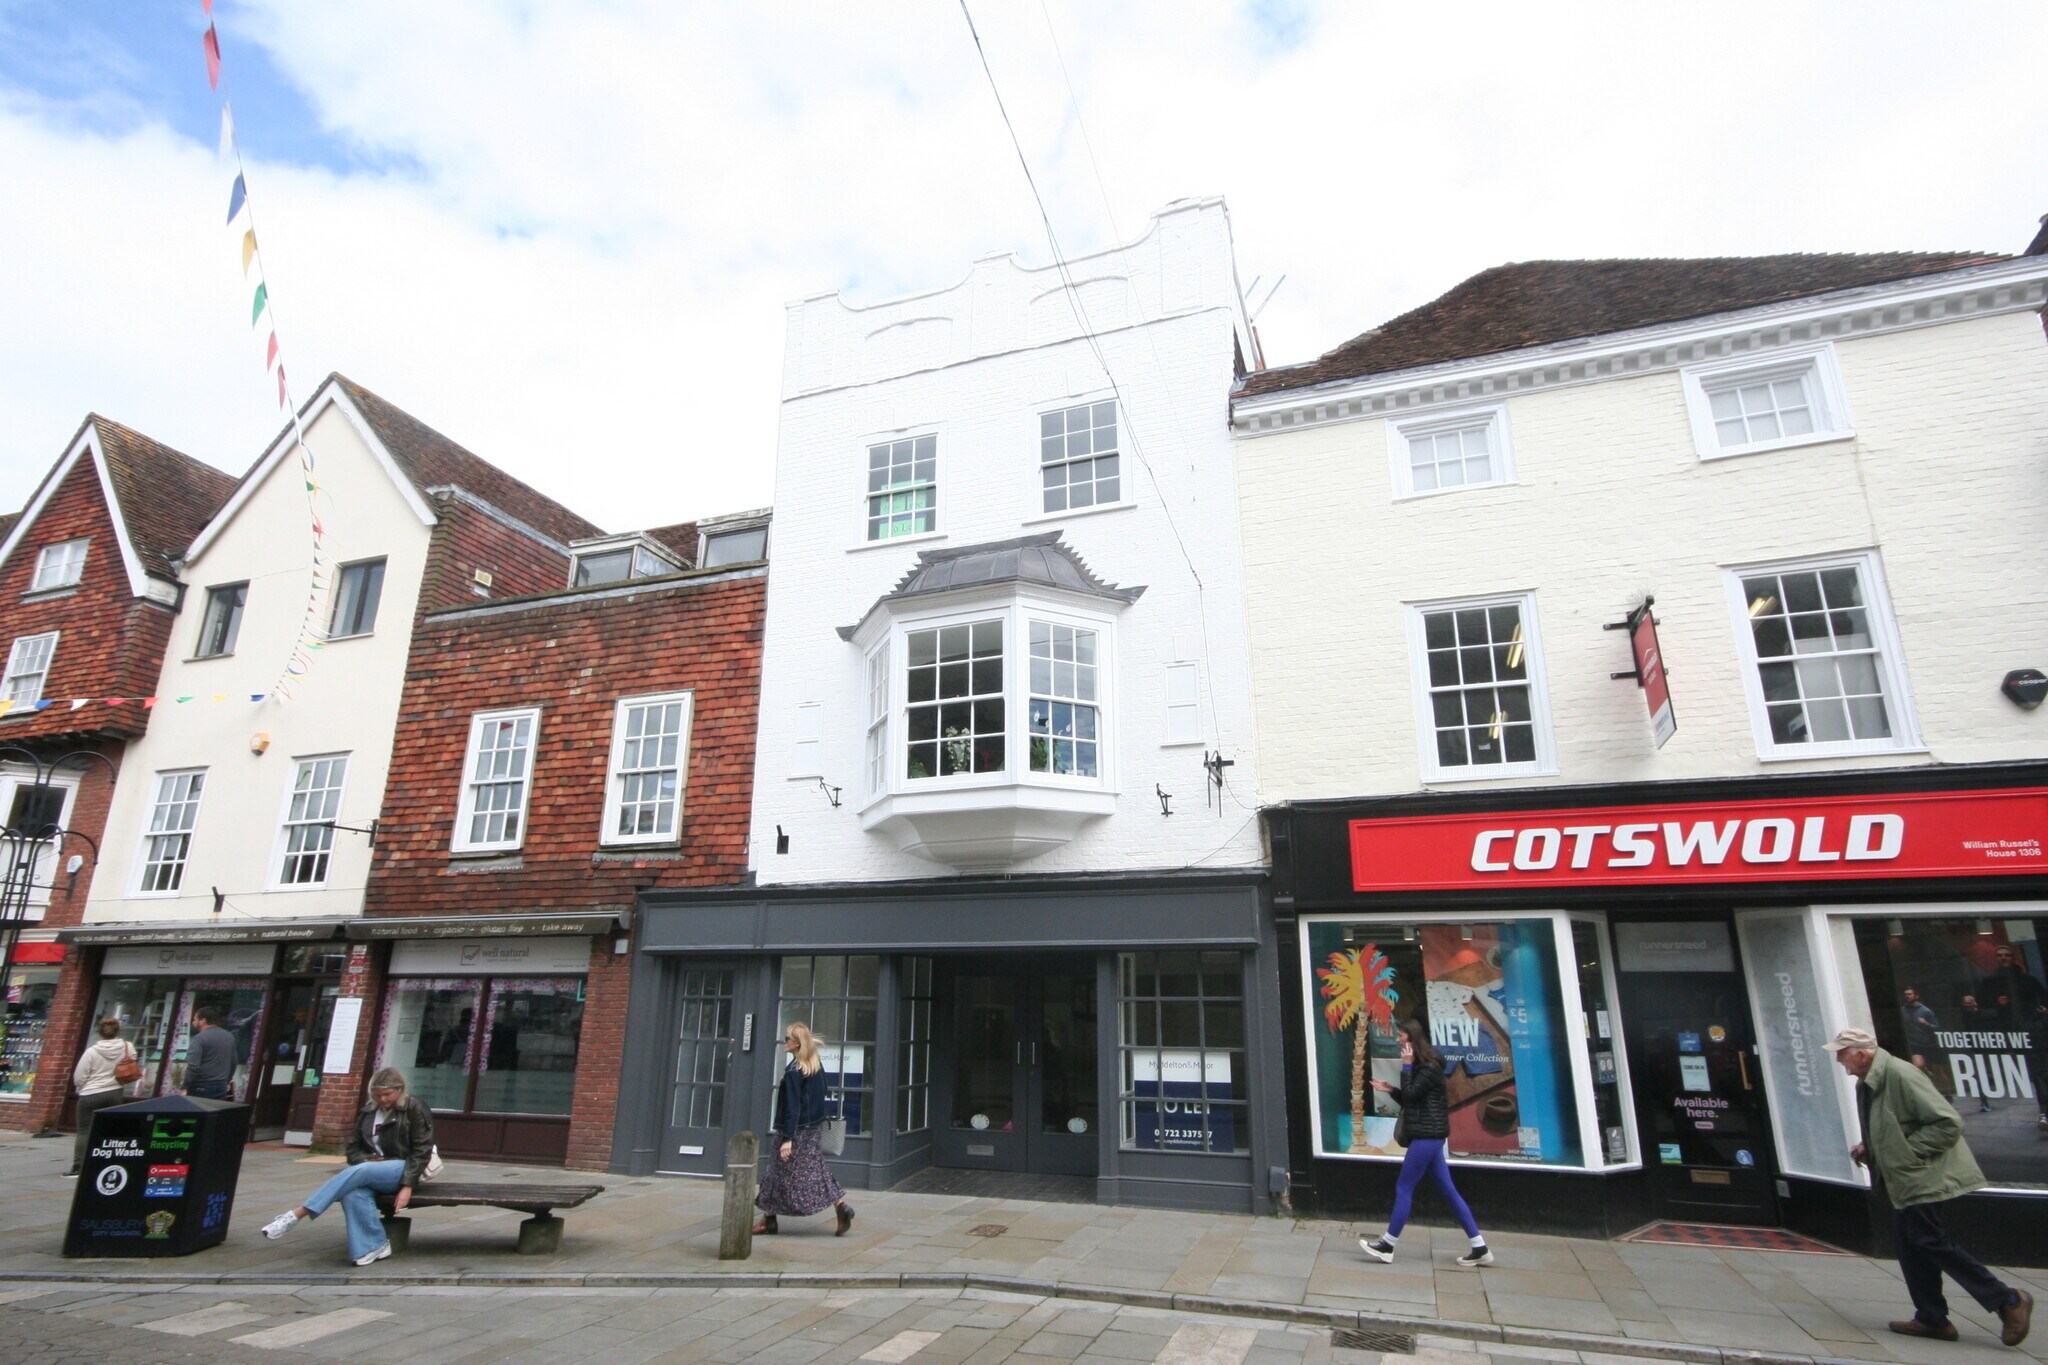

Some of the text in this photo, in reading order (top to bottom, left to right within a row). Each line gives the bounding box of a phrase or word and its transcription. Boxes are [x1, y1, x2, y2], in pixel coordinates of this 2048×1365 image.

[1470, 813, 1904, 872] COTSWOLD
[1962, 838, 2040, 849] William Russel's
[1986, 848, 2042, 857] House 1306
[261, 930, 287, 938] natural
[287, 928, 314, 938] beauty
[371, 926, 399, 935] natural
[400, 926, 418, 935] food
[433, 926, 465, 937] organic
[542, 923, 560, 931] take
[561, 923, 584, 933] away
[1640, 939, 1707, 950] runnersneed
[482, 946, 530, 958] well natural
[1430, 1017, 1479, 1047] NEW
[1774, 972, 1814, 1096] runnersneed
[1934, 1031, 2033, 1049] TOGETHER WE
[1444, 1052, 1510, 1063] mer Collection
[1948, 1053, 2034, 1099] RUN
[824, 1090, 845, 1102] LE
[1674, 1096, 1729, 1109] Available
[1686, 1107, 1719, 1118] here.
[1154, 1128, 1213, 1139] 0722 33757
[102, 1139, 138, 1149] Litter &
[150, 1140, 191, 1150] Recycling
[92, 1148, 145, 1159] Dog Waste
[79, 1218, 144, 1230] SALISBURY
